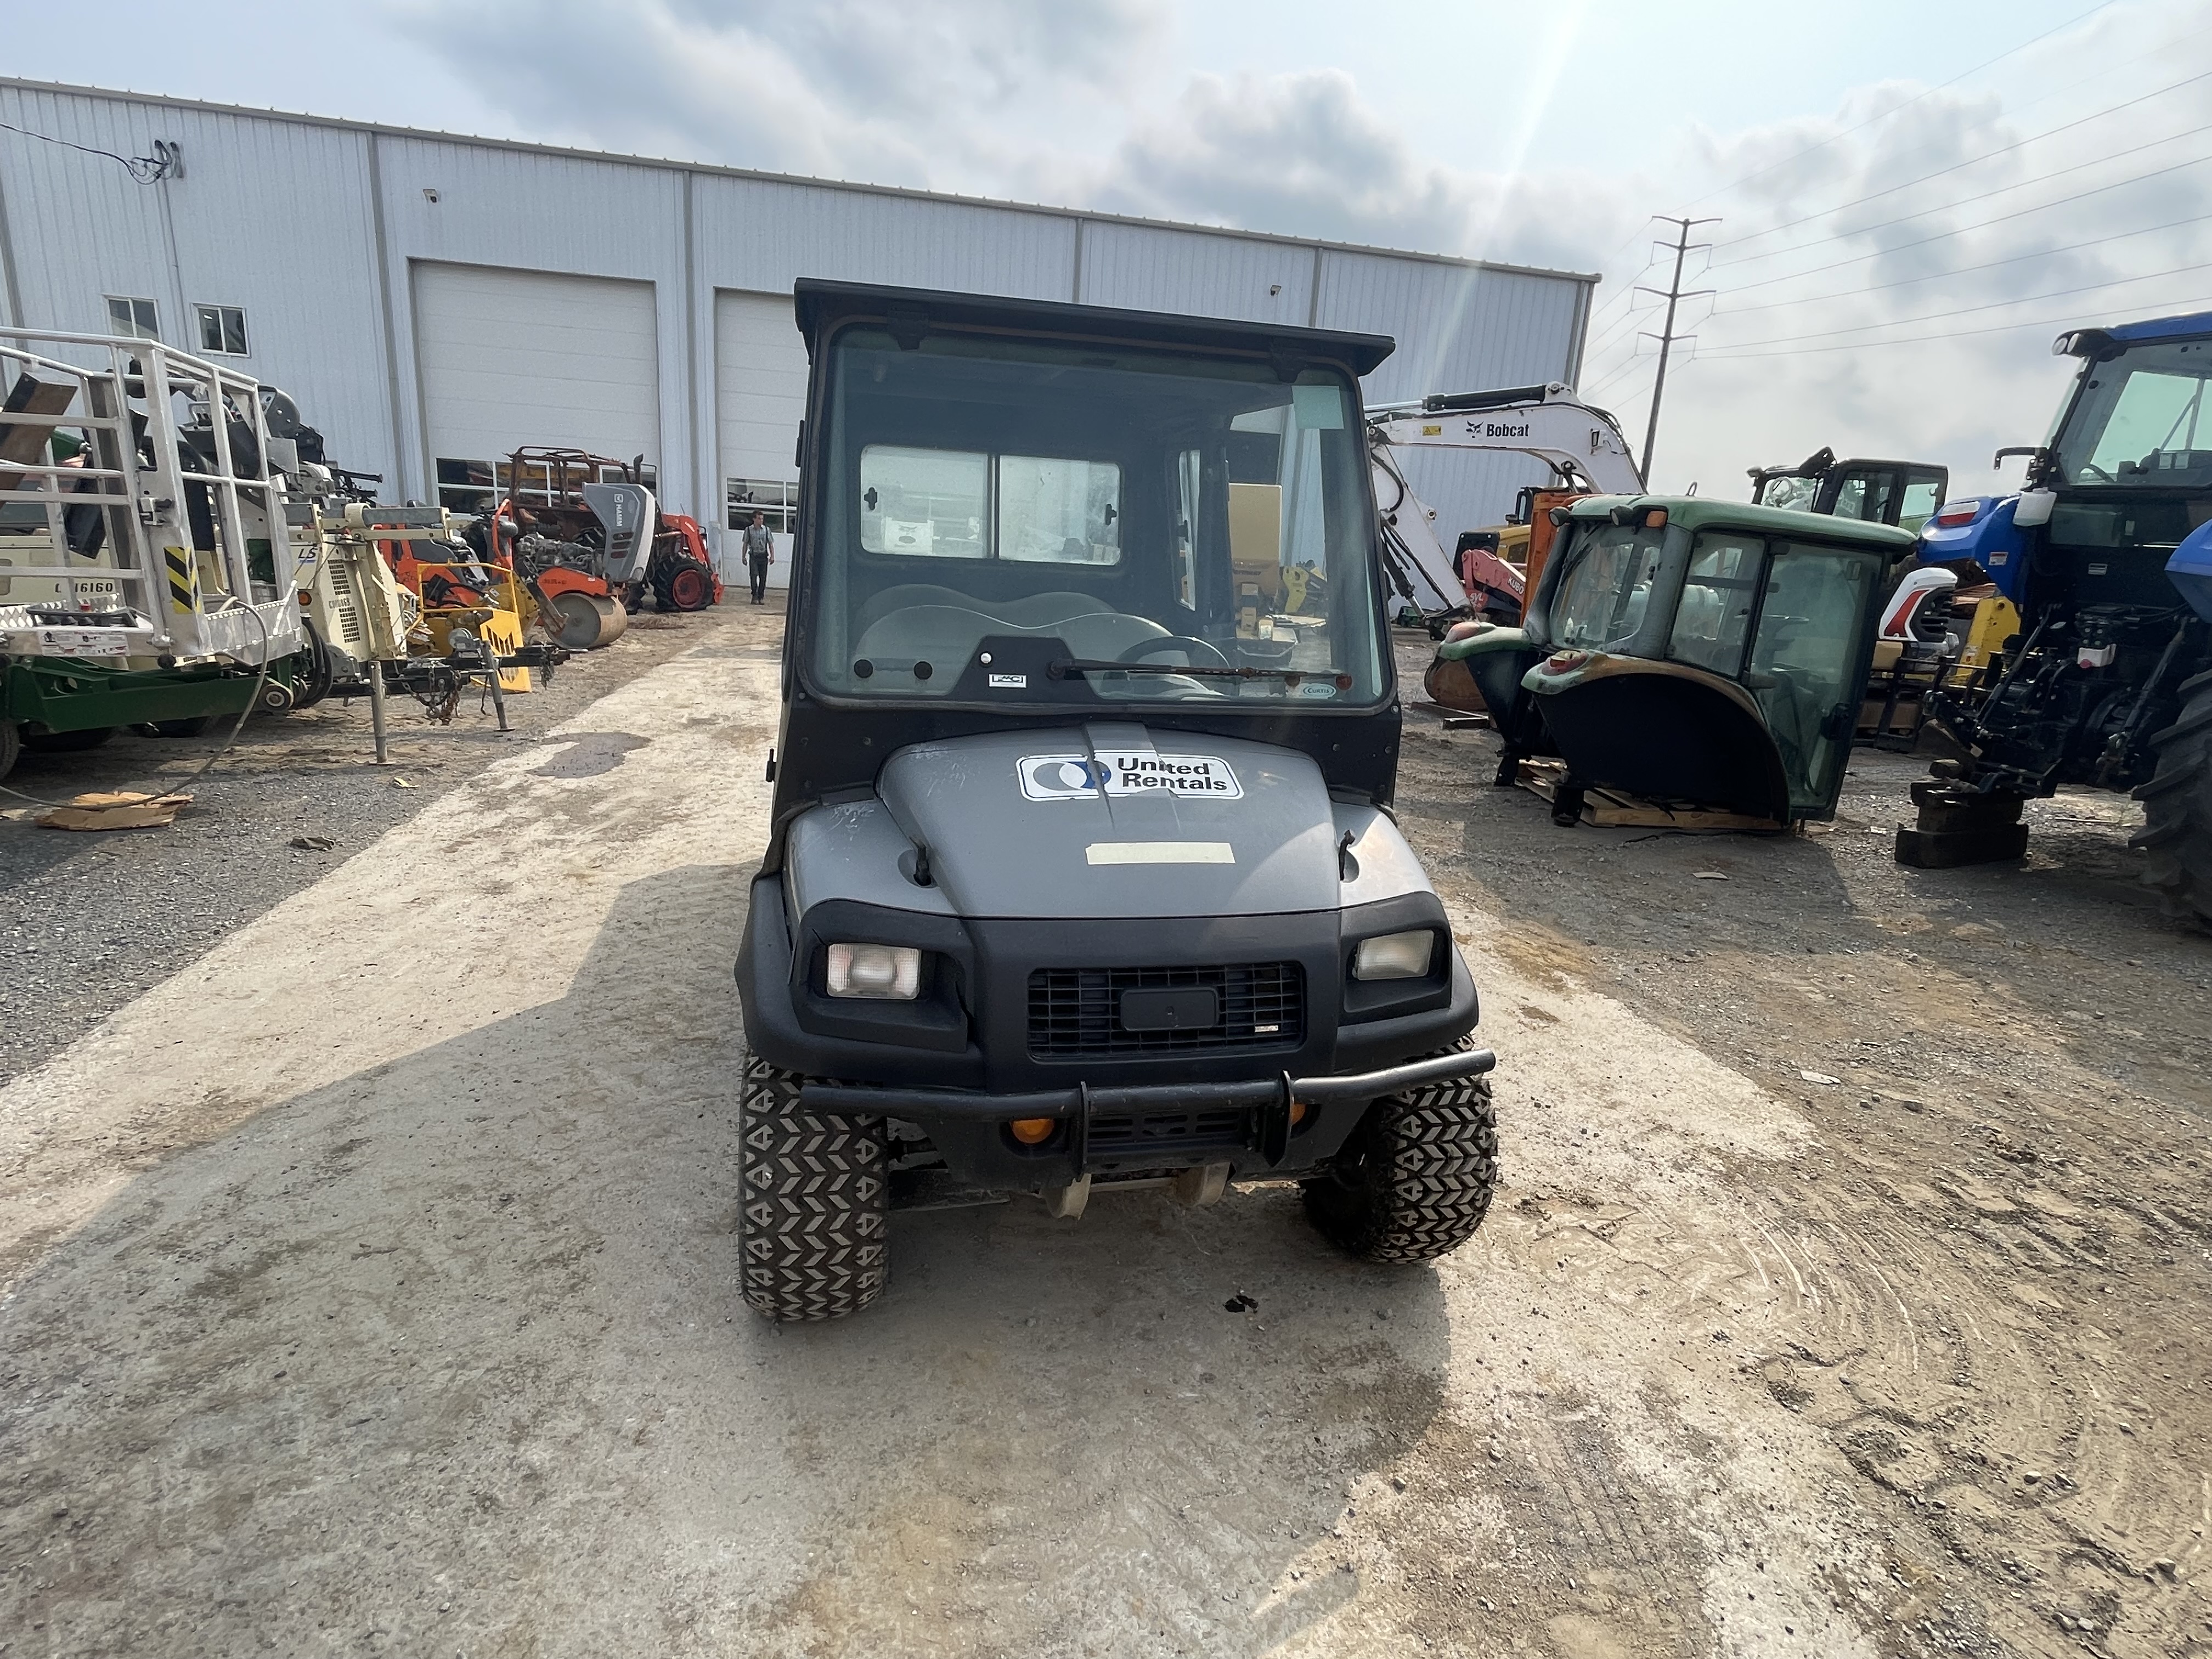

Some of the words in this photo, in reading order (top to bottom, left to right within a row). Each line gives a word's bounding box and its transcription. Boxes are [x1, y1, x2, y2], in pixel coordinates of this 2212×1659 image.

[1487, 424, 1529, 437] Bobcat
[1118, 757, 1210, 775] United
[1122, 772, 1228, 791] Rentals
